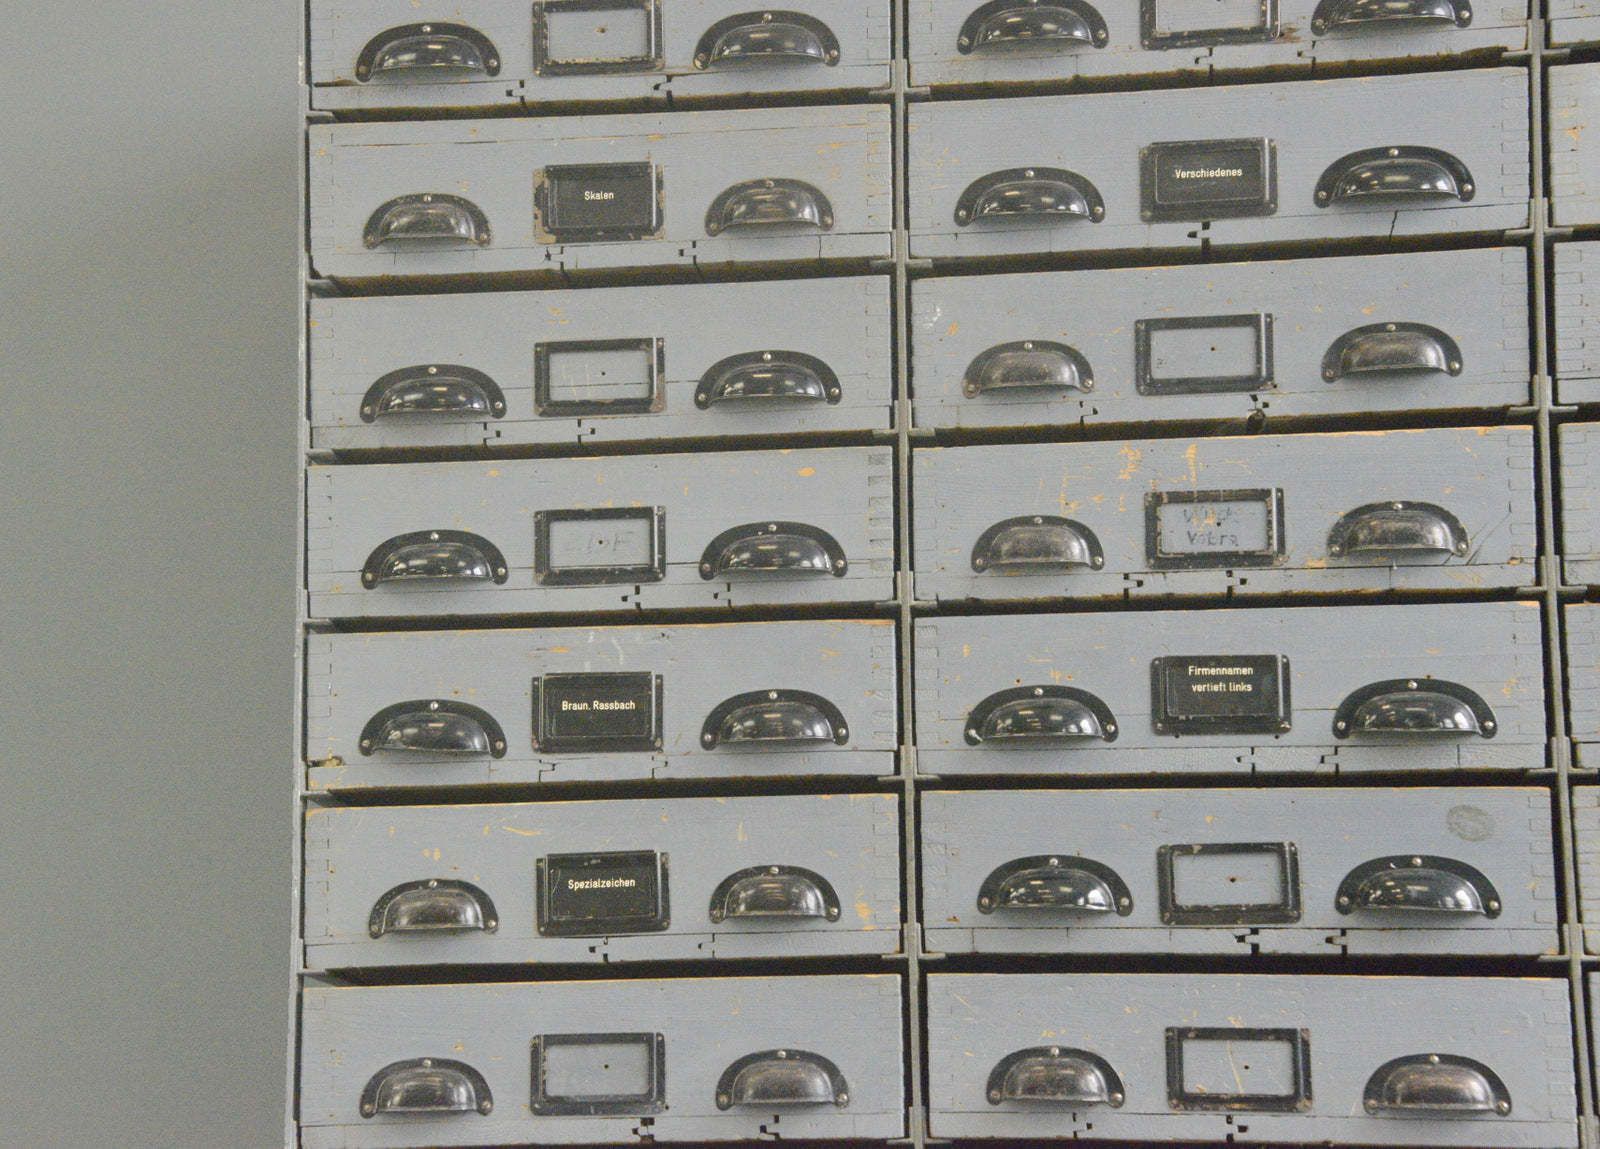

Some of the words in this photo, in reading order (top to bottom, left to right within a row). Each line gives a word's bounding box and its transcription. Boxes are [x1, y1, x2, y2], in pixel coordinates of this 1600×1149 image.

[1175, 168, 1243, 179] Verschiedenes
[584, 190, 615, 201] Skalen
[1188, 665, 1254, 676] Firmennamen
[1191, 682, 1226, 692] vertieft
[1229, 682, 1253, 692] links
[593, 700, 636, 710] Rassbach
[568, 877, 636, 891] Spezialzeichen
